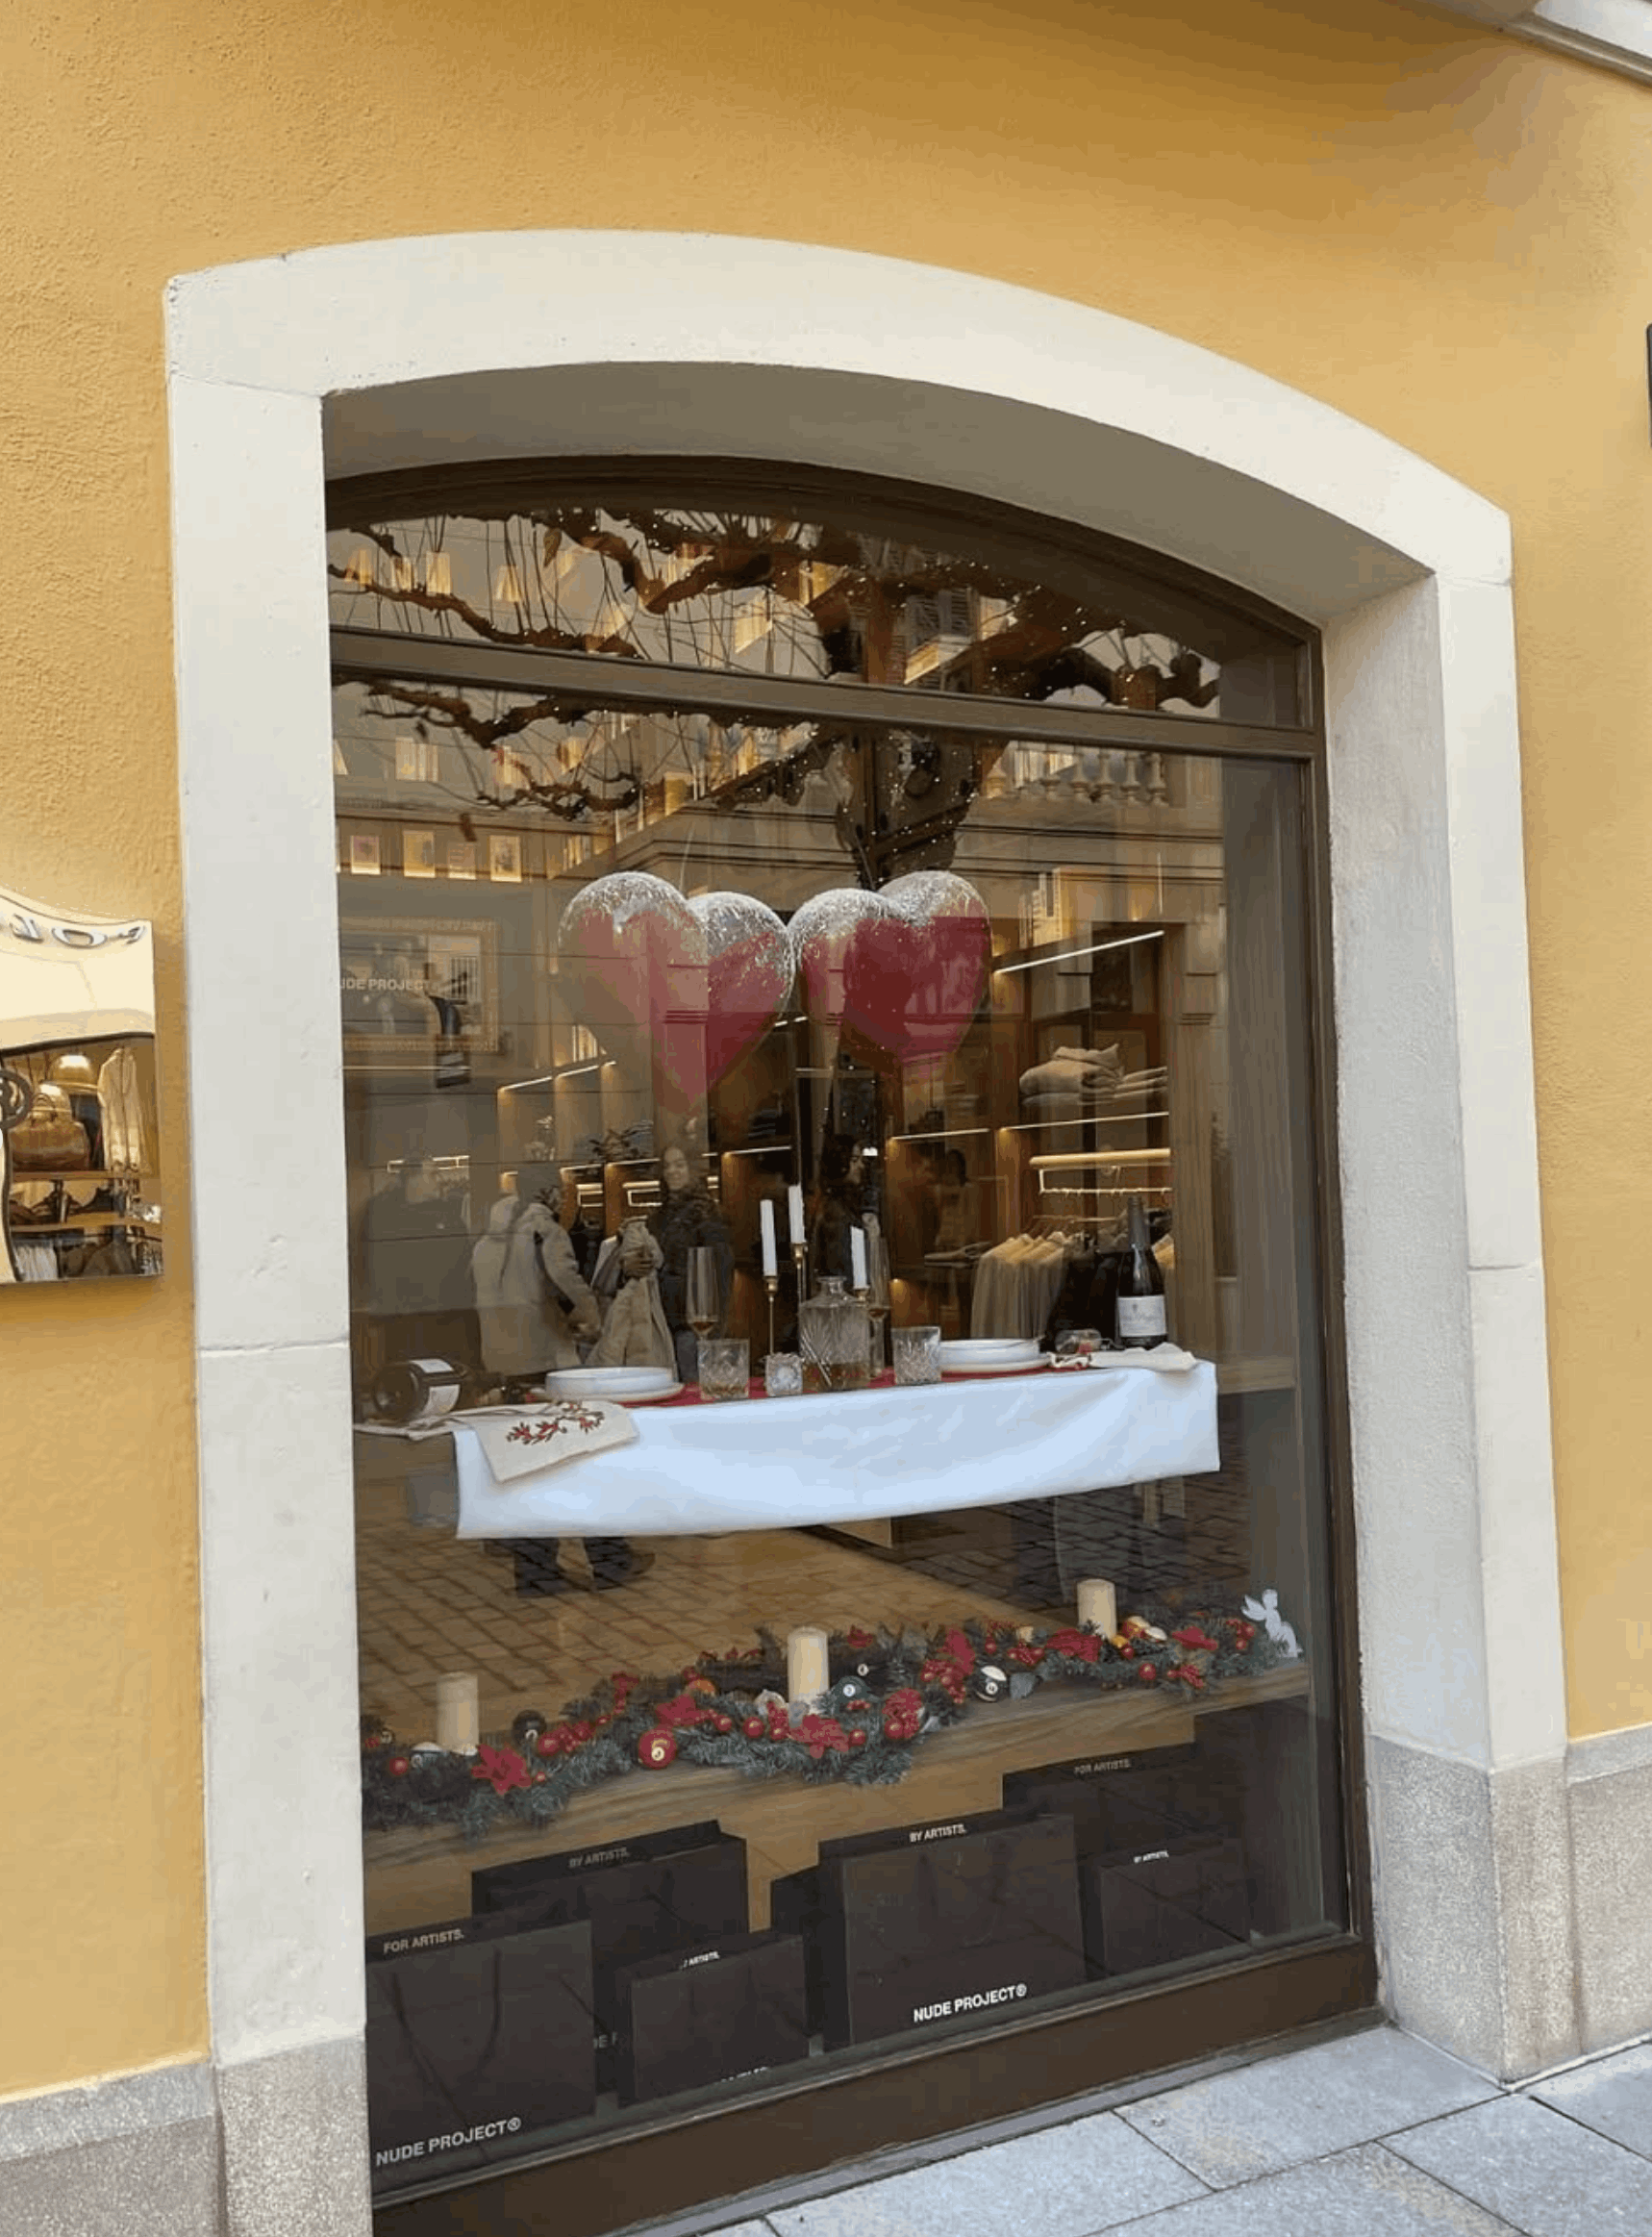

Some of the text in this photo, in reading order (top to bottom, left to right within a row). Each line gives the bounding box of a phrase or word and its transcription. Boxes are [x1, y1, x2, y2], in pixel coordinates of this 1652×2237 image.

[909, 1831, 923, 1842] BY
[384, 1928, 465, 1954] FOR ARTISTS.
[914, 1983, 1027, 2023] NUDE PROJECT®
[376, 2117, 522, 2166] NUDE PROJECT®
